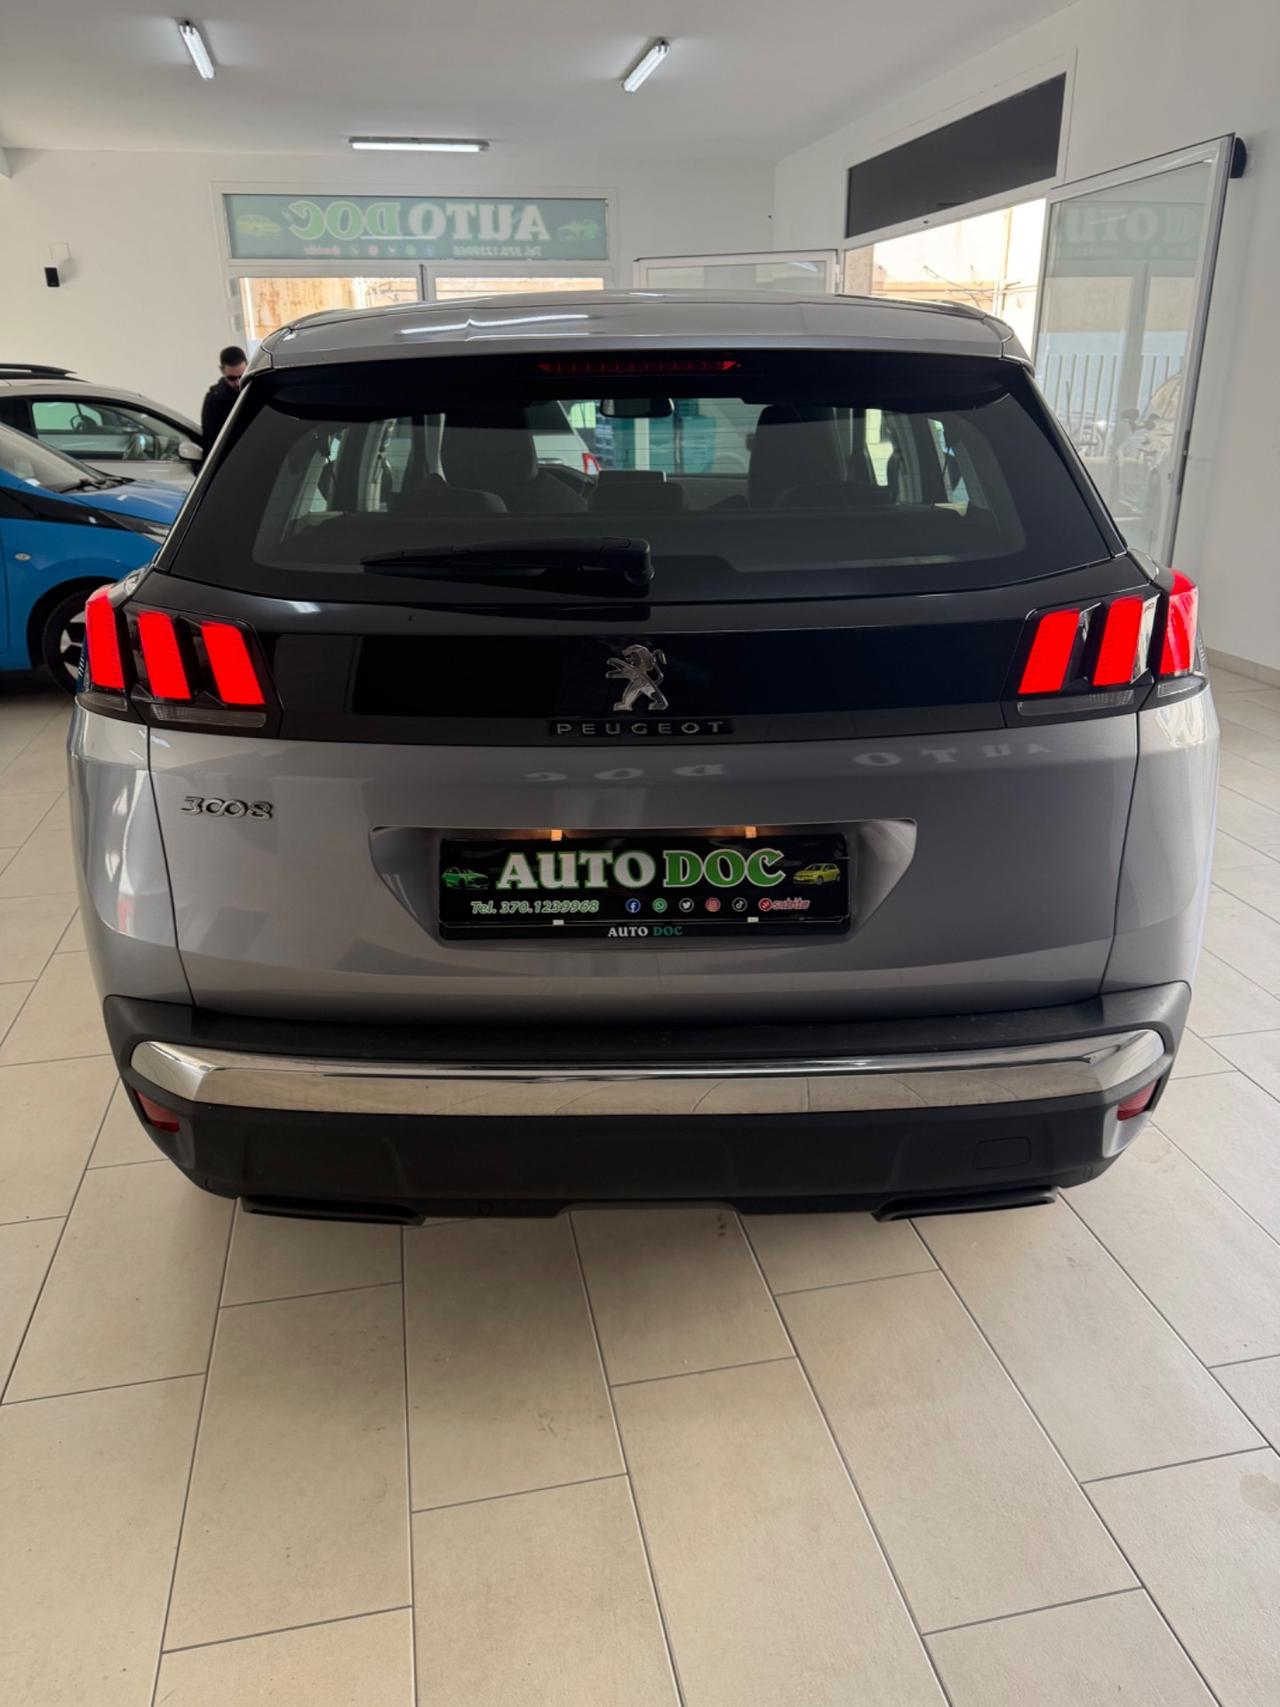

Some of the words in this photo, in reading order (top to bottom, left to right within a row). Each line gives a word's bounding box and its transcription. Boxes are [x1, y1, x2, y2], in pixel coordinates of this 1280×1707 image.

[556, 721, 723, 735] PEUGEOT
[181, 796, 273, 820] 3008
[496, 850, 656, 890] AUTO
[663, 848, 787, 888] DOC
[470, 901, 497, 914] Tel.
[608, 926, 648, 937] AUTO
[653, 926, 683, 936] DOC
